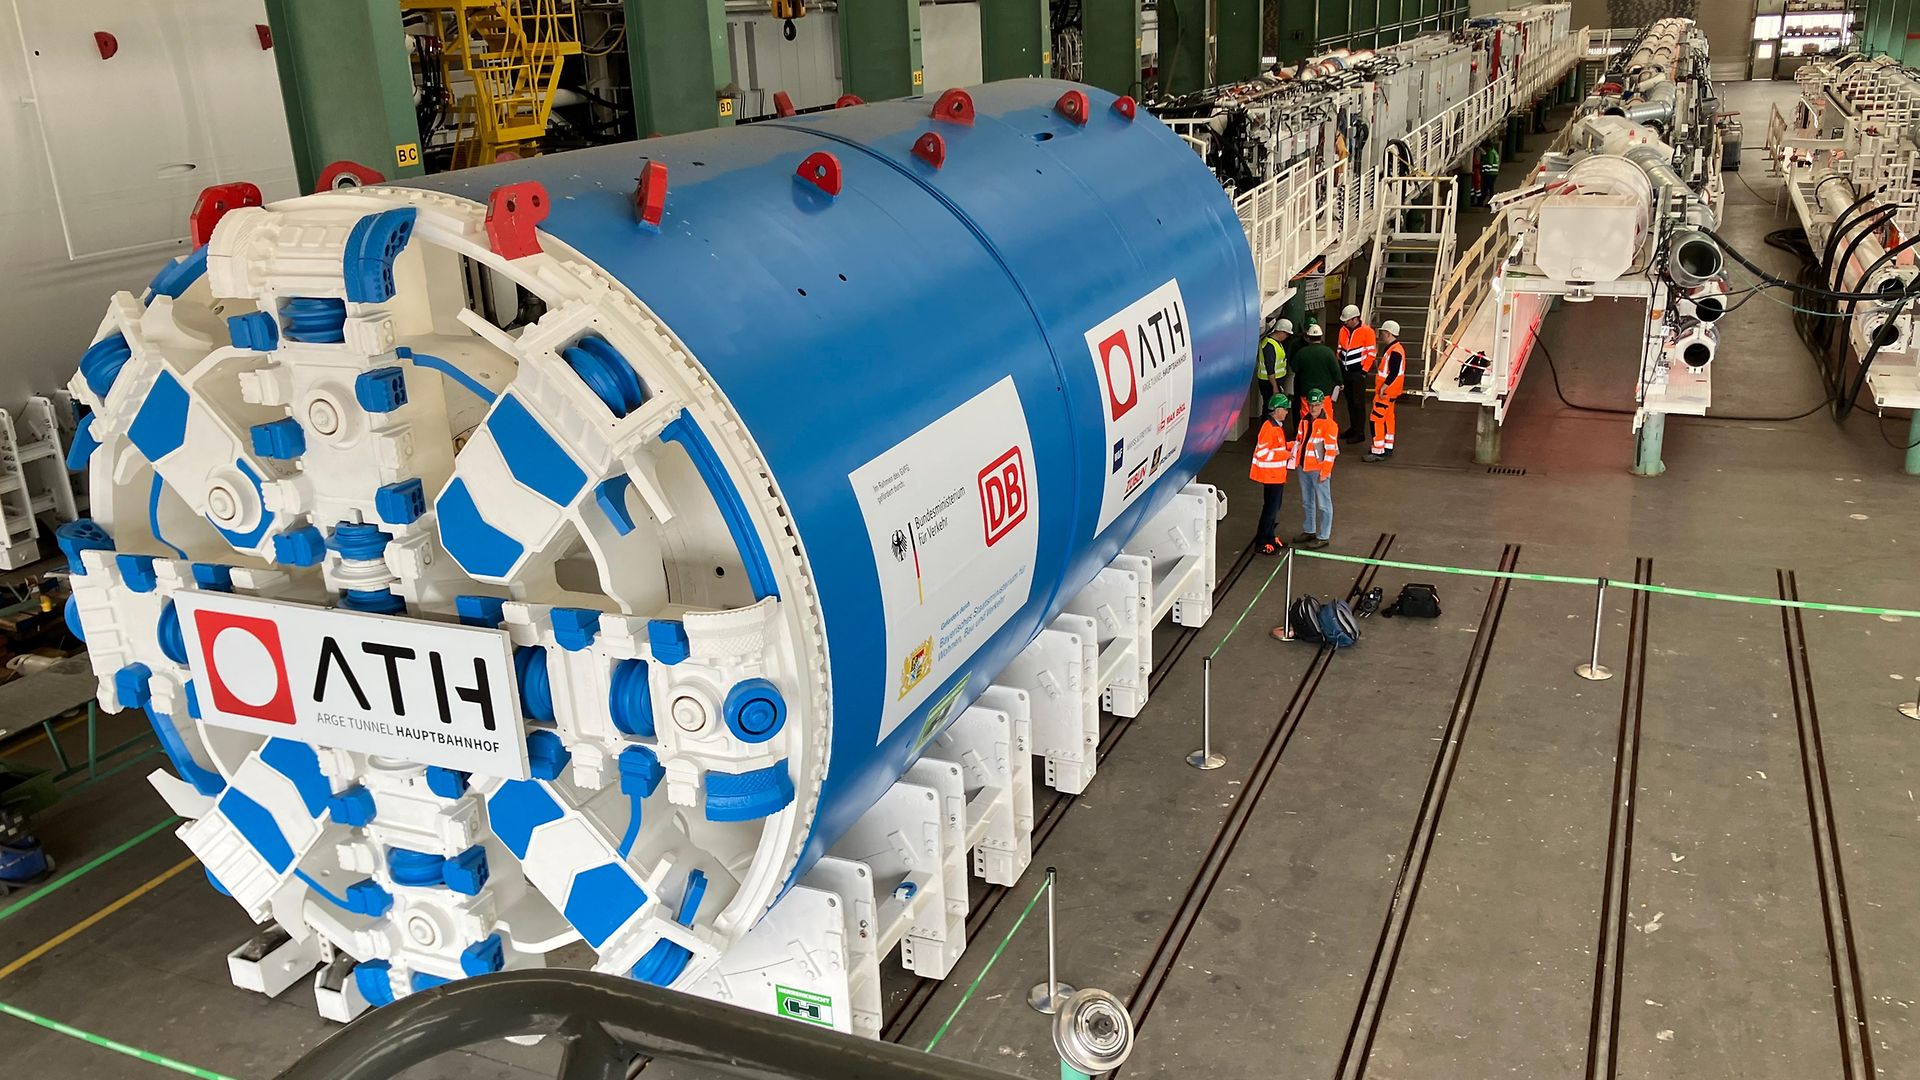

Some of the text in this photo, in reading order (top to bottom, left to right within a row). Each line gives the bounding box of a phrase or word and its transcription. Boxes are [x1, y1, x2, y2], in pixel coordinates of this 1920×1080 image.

[720, 102, 732, 113] BD
[398, 148, 417, 162] BC
[1137, 301, 1185, 378] ATH
[914, 486, 966, 530] Bundesministerium
[985, 463, 1022, 532] DB
[918, 516, 948, 546] für Verkehr
[313, 636, 496, 731] ATH
[317, 712, 500, 753] ARGE TUNNEL HAUPTBAHNHOF
